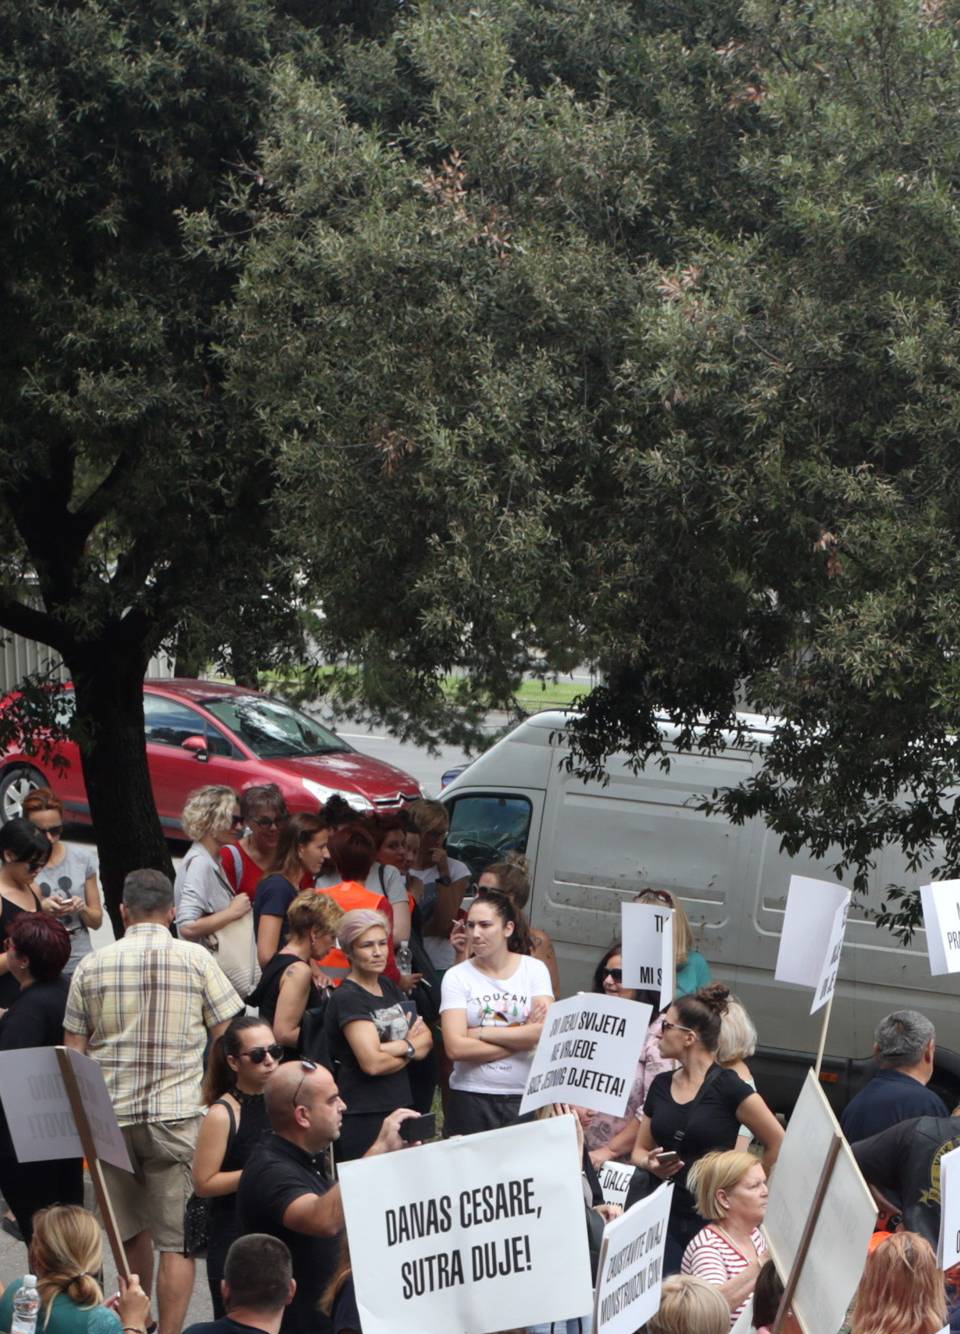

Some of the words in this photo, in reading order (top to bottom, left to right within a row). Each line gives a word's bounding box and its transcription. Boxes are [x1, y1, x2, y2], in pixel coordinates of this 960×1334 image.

[640, 966, 654, 984] MI
[476, 991, 528, 1007] TOUCAN
[578, 1010, 627, 1038] SVIJETA
[560, 1039, 598, 1060] VRIJEDE
[567, 1066, 626, 1097] DJETETA!
[385, 1195, 452, 1247] DANAS
[459, 1177, 543, 1229] CESARE,
[606, 1231, 647, 1284] ZAUSTAVITE
[645, 1217, 665, 1254] OVAJ
[401, 1249, 464, 1301] SUTRA
[471, 1235, 532, 1283] DUJE!
